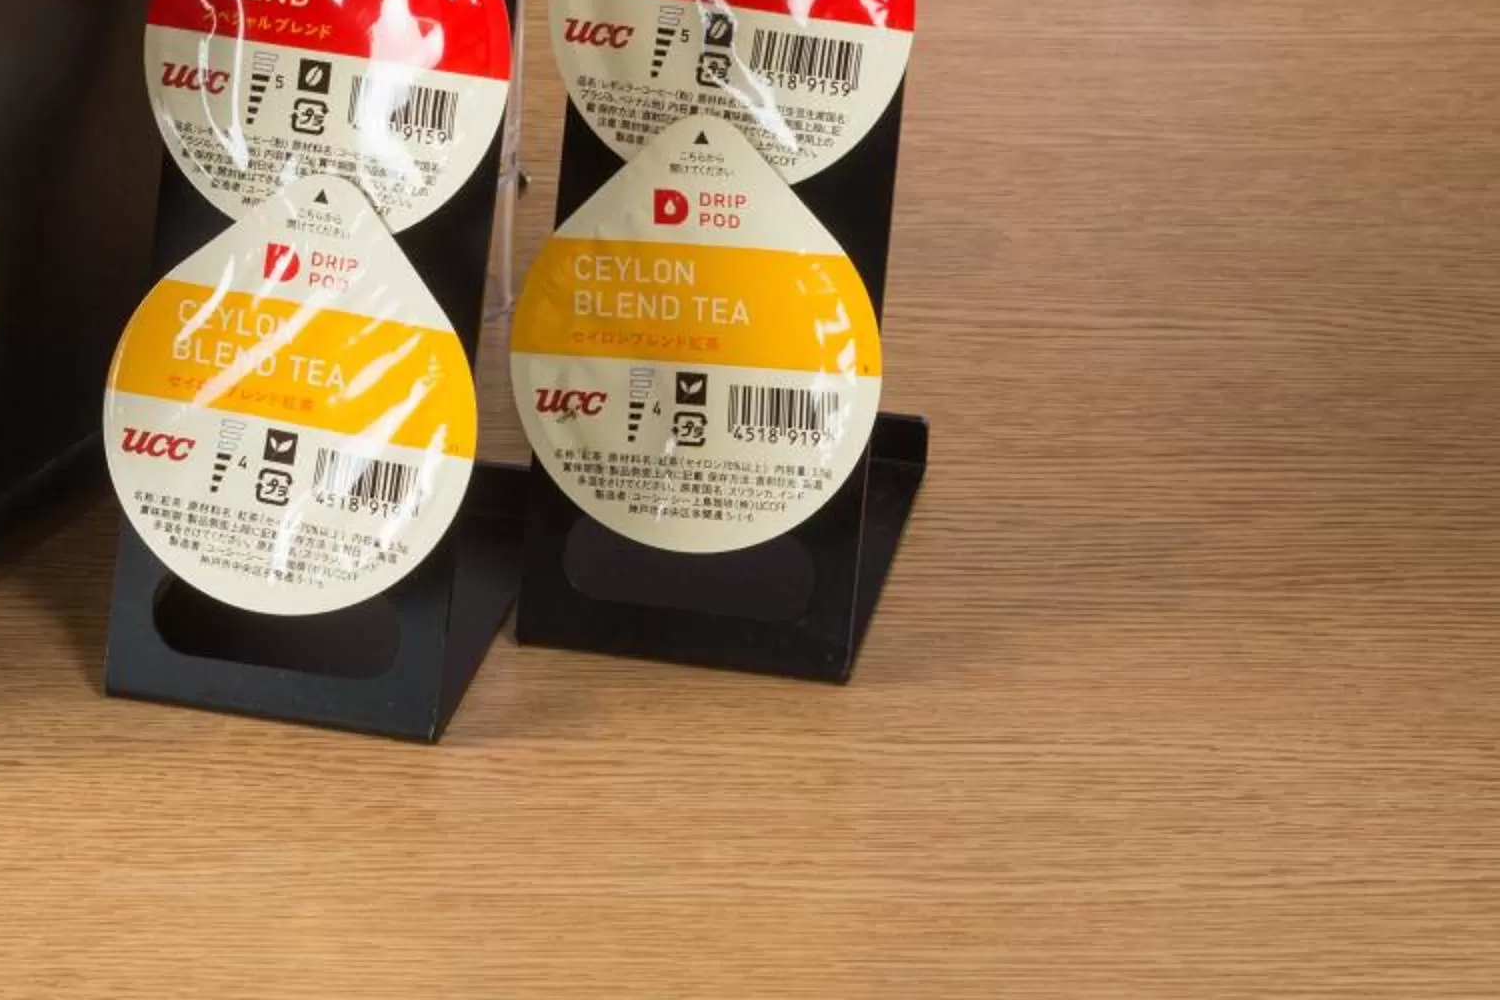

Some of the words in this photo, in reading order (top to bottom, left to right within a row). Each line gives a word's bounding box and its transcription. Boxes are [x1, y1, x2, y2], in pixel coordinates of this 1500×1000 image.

[680, 28, 690, 43] 5
[807, 78, 852, 98] 9159
[700, 191, 747, 208] DRIP
[700, 213, 741, 229] POD
[311, 250, 359, 273] DRIP
[574, 253, 696, 287] CEYLON
[574, 289, 682, 321] BLEND
[691, 295, 750, 326] TEA
[290, 354, 348, 392] TEA
[733, 426, 779, 444] 4518
[238, 456, 247, 470] 4
[316, 491, 360, 513] 4518
